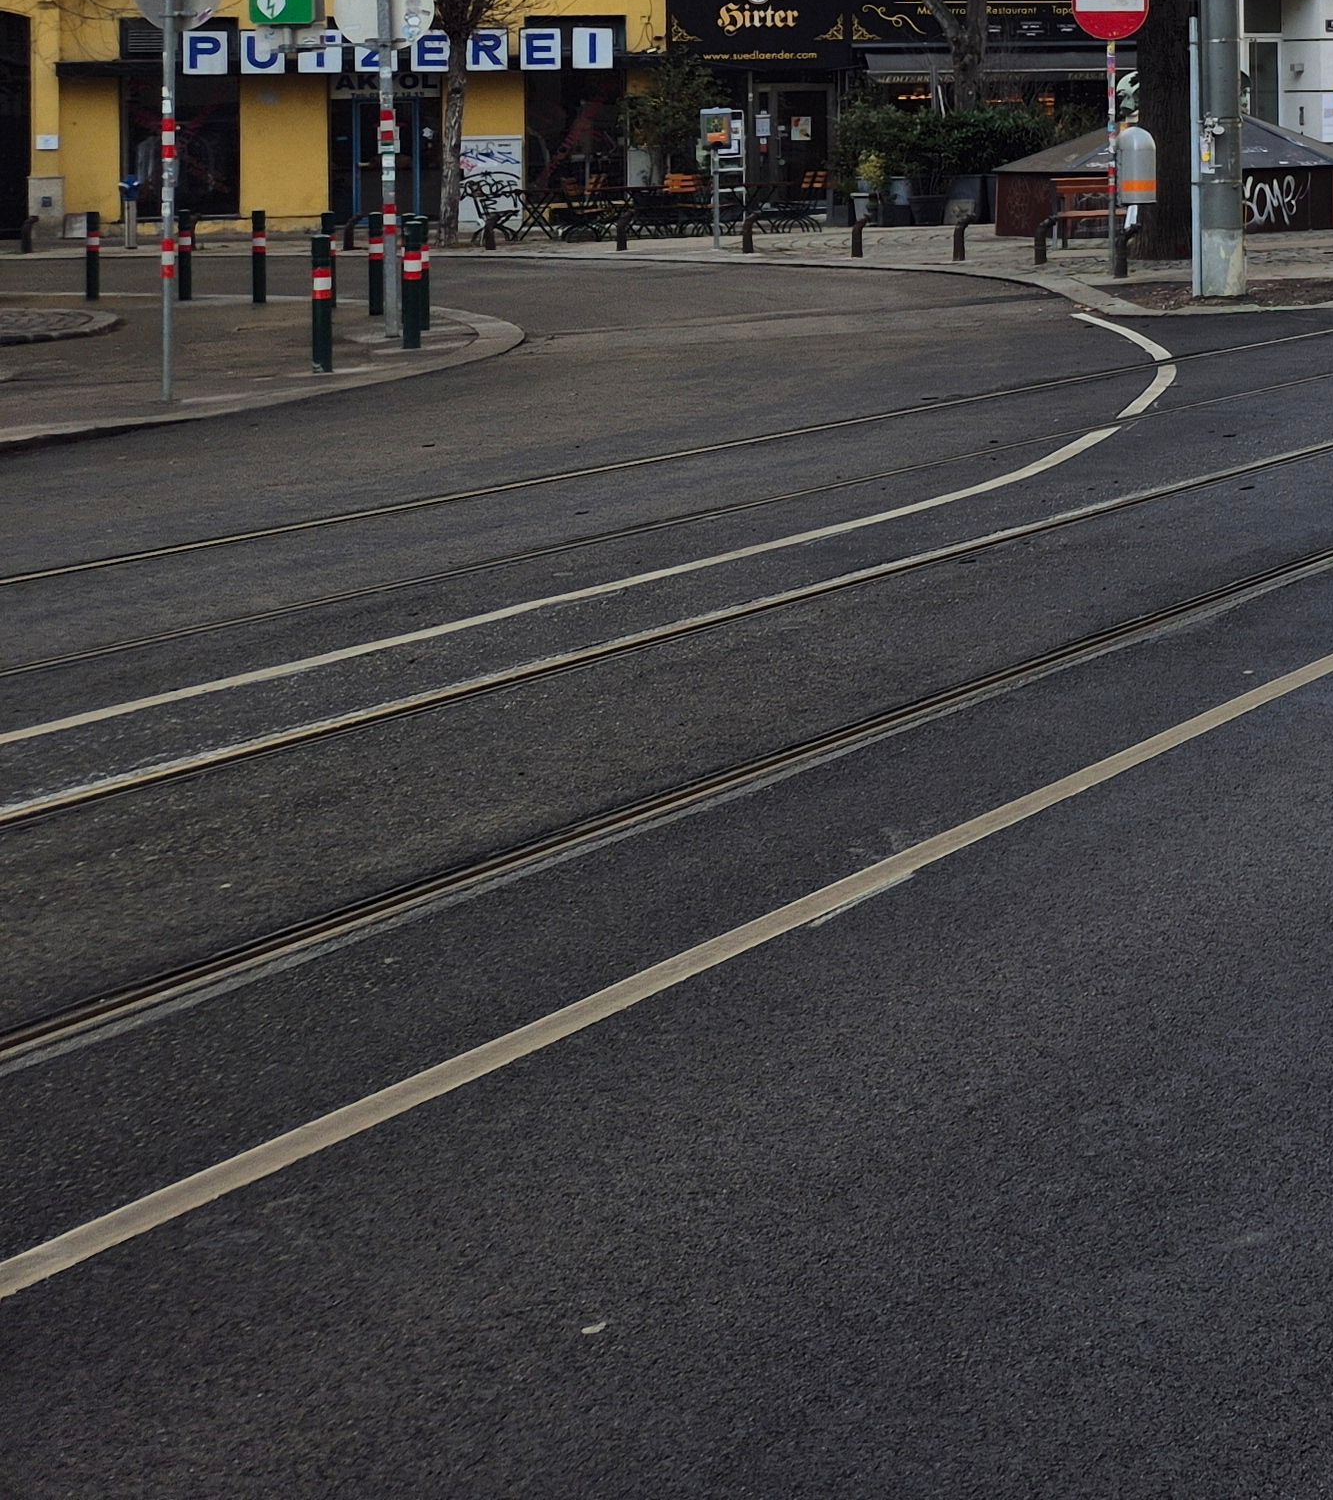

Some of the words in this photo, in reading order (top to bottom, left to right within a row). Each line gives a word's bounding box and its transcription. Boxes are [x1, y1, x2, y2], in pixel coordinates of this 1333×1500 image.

[986, 5, 1037, 15] Restaurant
[717, 2, 799, 37] Hirter
[702, 49, 818, 60] www.suedlaender.com
[335, 73, 438, 90] AKOL
